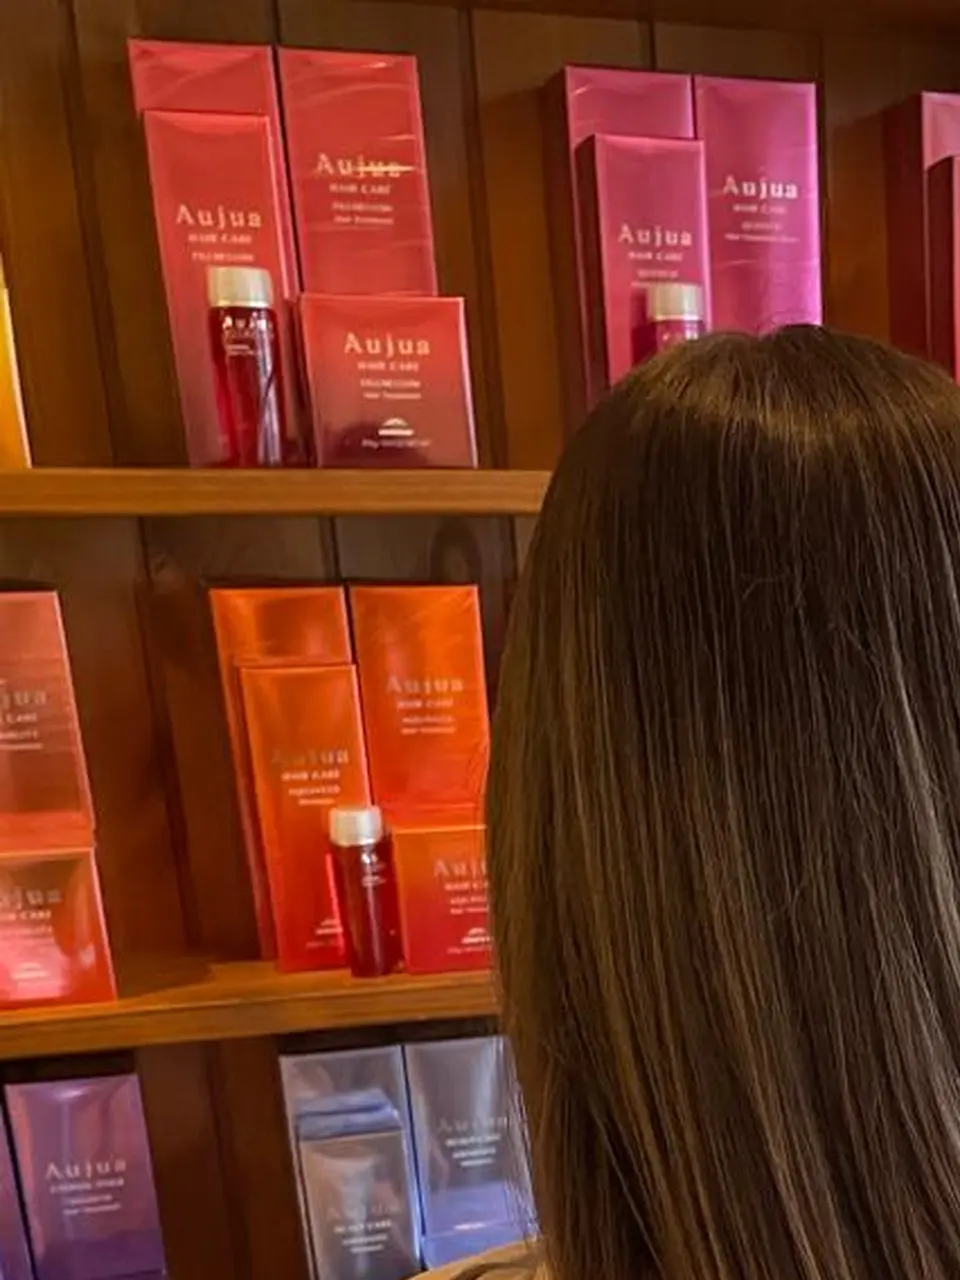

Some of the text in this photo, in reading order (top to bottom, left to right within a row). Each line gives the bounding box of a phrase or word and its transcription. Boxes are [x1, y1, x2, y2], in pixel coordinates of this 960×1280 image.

[722, 174, 798, 200] Aujua
[175, 204, 262, 230] Aujua
[618, 223, 693, 248] Aujua
[344, 331, 431, 359] Aujua
[44, 1158, 127, 1181] Aujua
